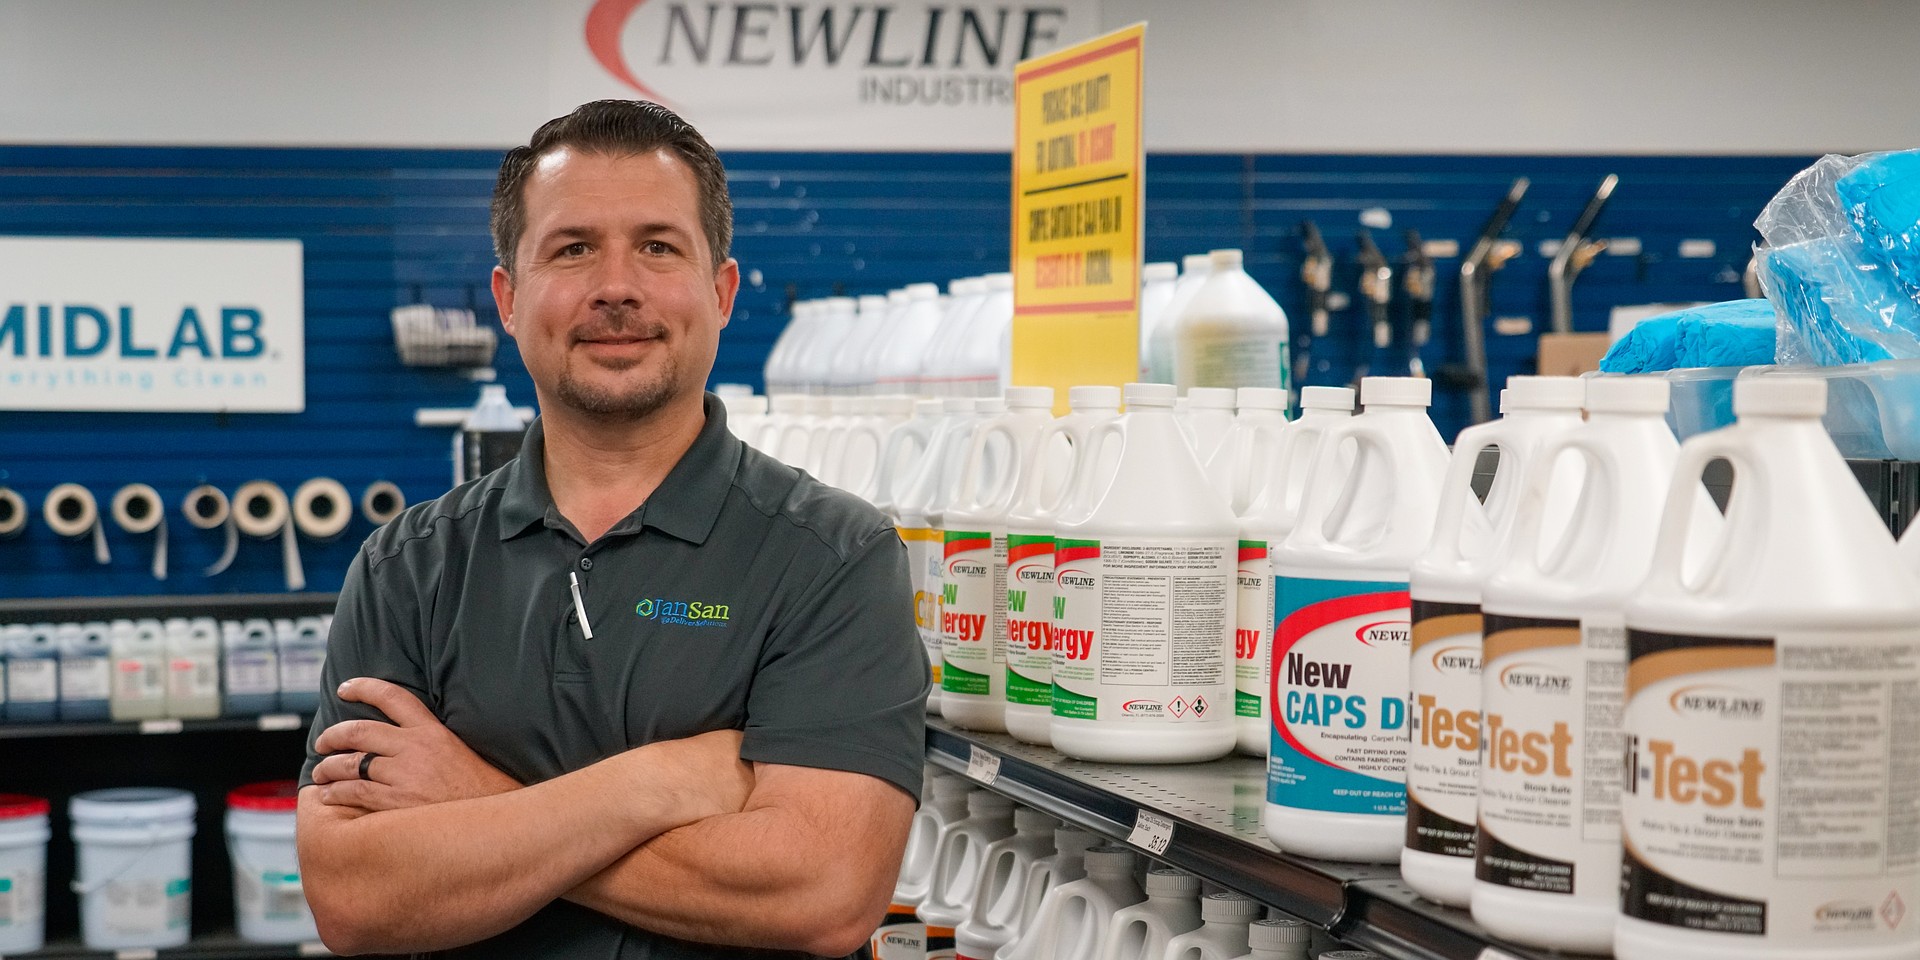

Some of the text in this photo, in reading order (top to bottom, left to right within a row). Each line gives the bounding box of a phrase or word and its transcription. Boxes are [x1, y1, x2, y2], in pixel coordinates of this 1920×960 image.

[858, 75, 1014, 106] INDUSTR
[953, 565, 987, 575] NEWLINE
[1061, 576, 1095, 587] NEWLINE
[650, 599, 729, 620] JanSan
[1369, 630, 1410, 641] NEWL
[1441, 656, 1482, 669] NEWLI
[1288, 652, 1352, 689] New
[1286, 691, 1367, 729] CAPS
[1321, 732, 1368, 742] Encapsulating
[1346, 747, 1361, 755] FAST
[1334, 755, 1365, 763] CONTAINS
[1383, 764, 1406, 772] CONCE
[1148, 835, 1167, 851] 35.12
[887, 936, 920, 947] NEWLINE
